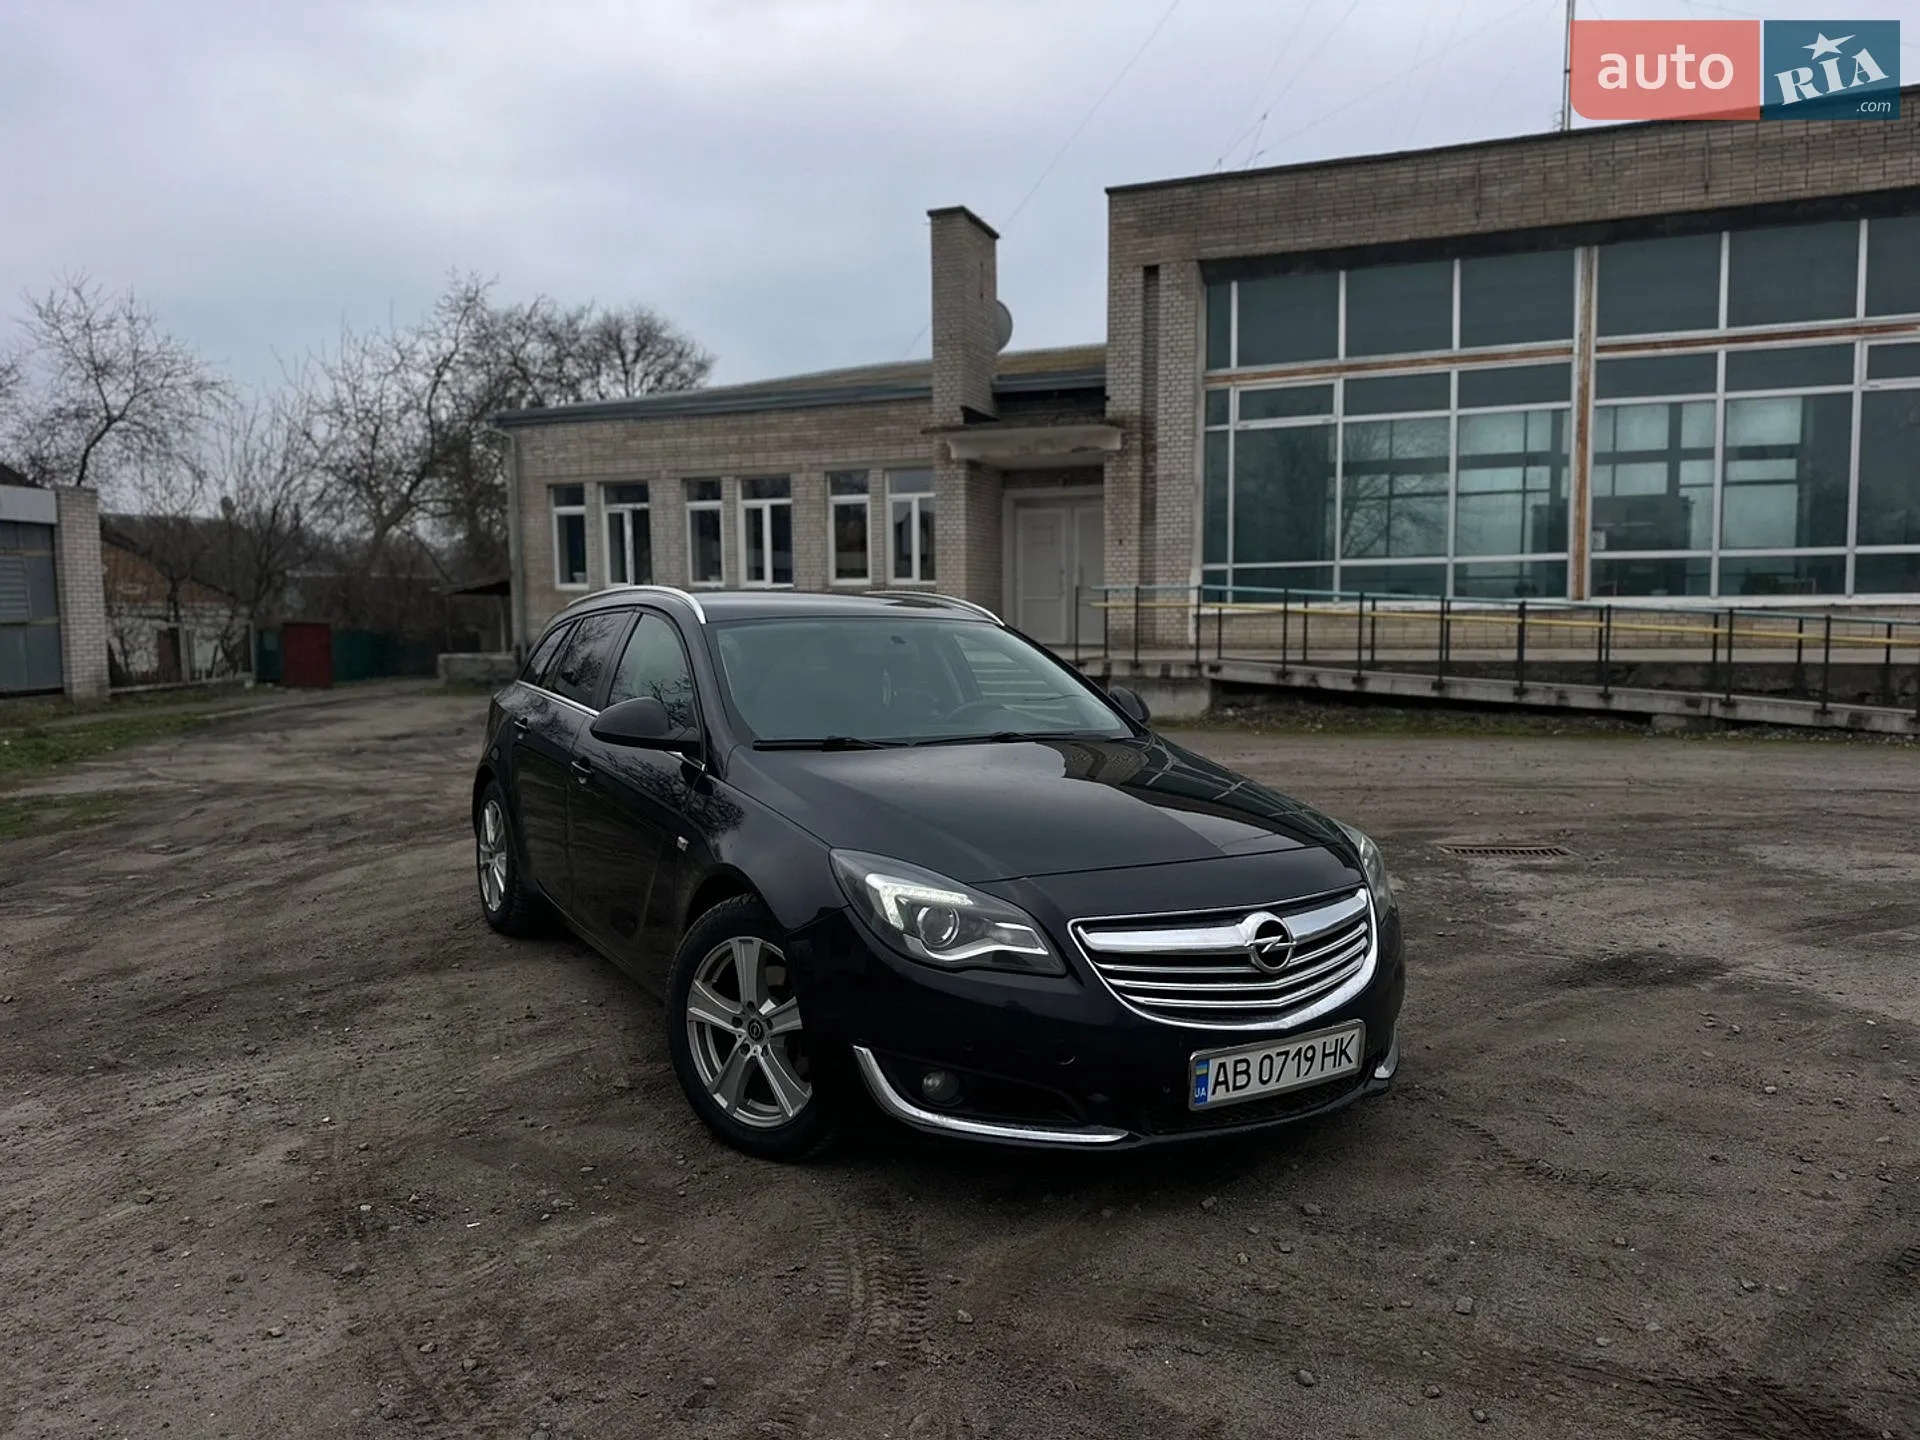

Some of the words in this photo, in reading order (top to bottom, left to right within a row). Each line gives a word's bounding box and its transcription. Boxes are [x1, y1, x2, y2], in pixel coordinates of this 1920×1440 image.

[1211, 1059, 1252, 1096] AB
[1258, 1045, 1316, 1085] 0719
[1320, 1034, 1356, 1072] HK
[1195, 1087, 1207, 1098] UA
